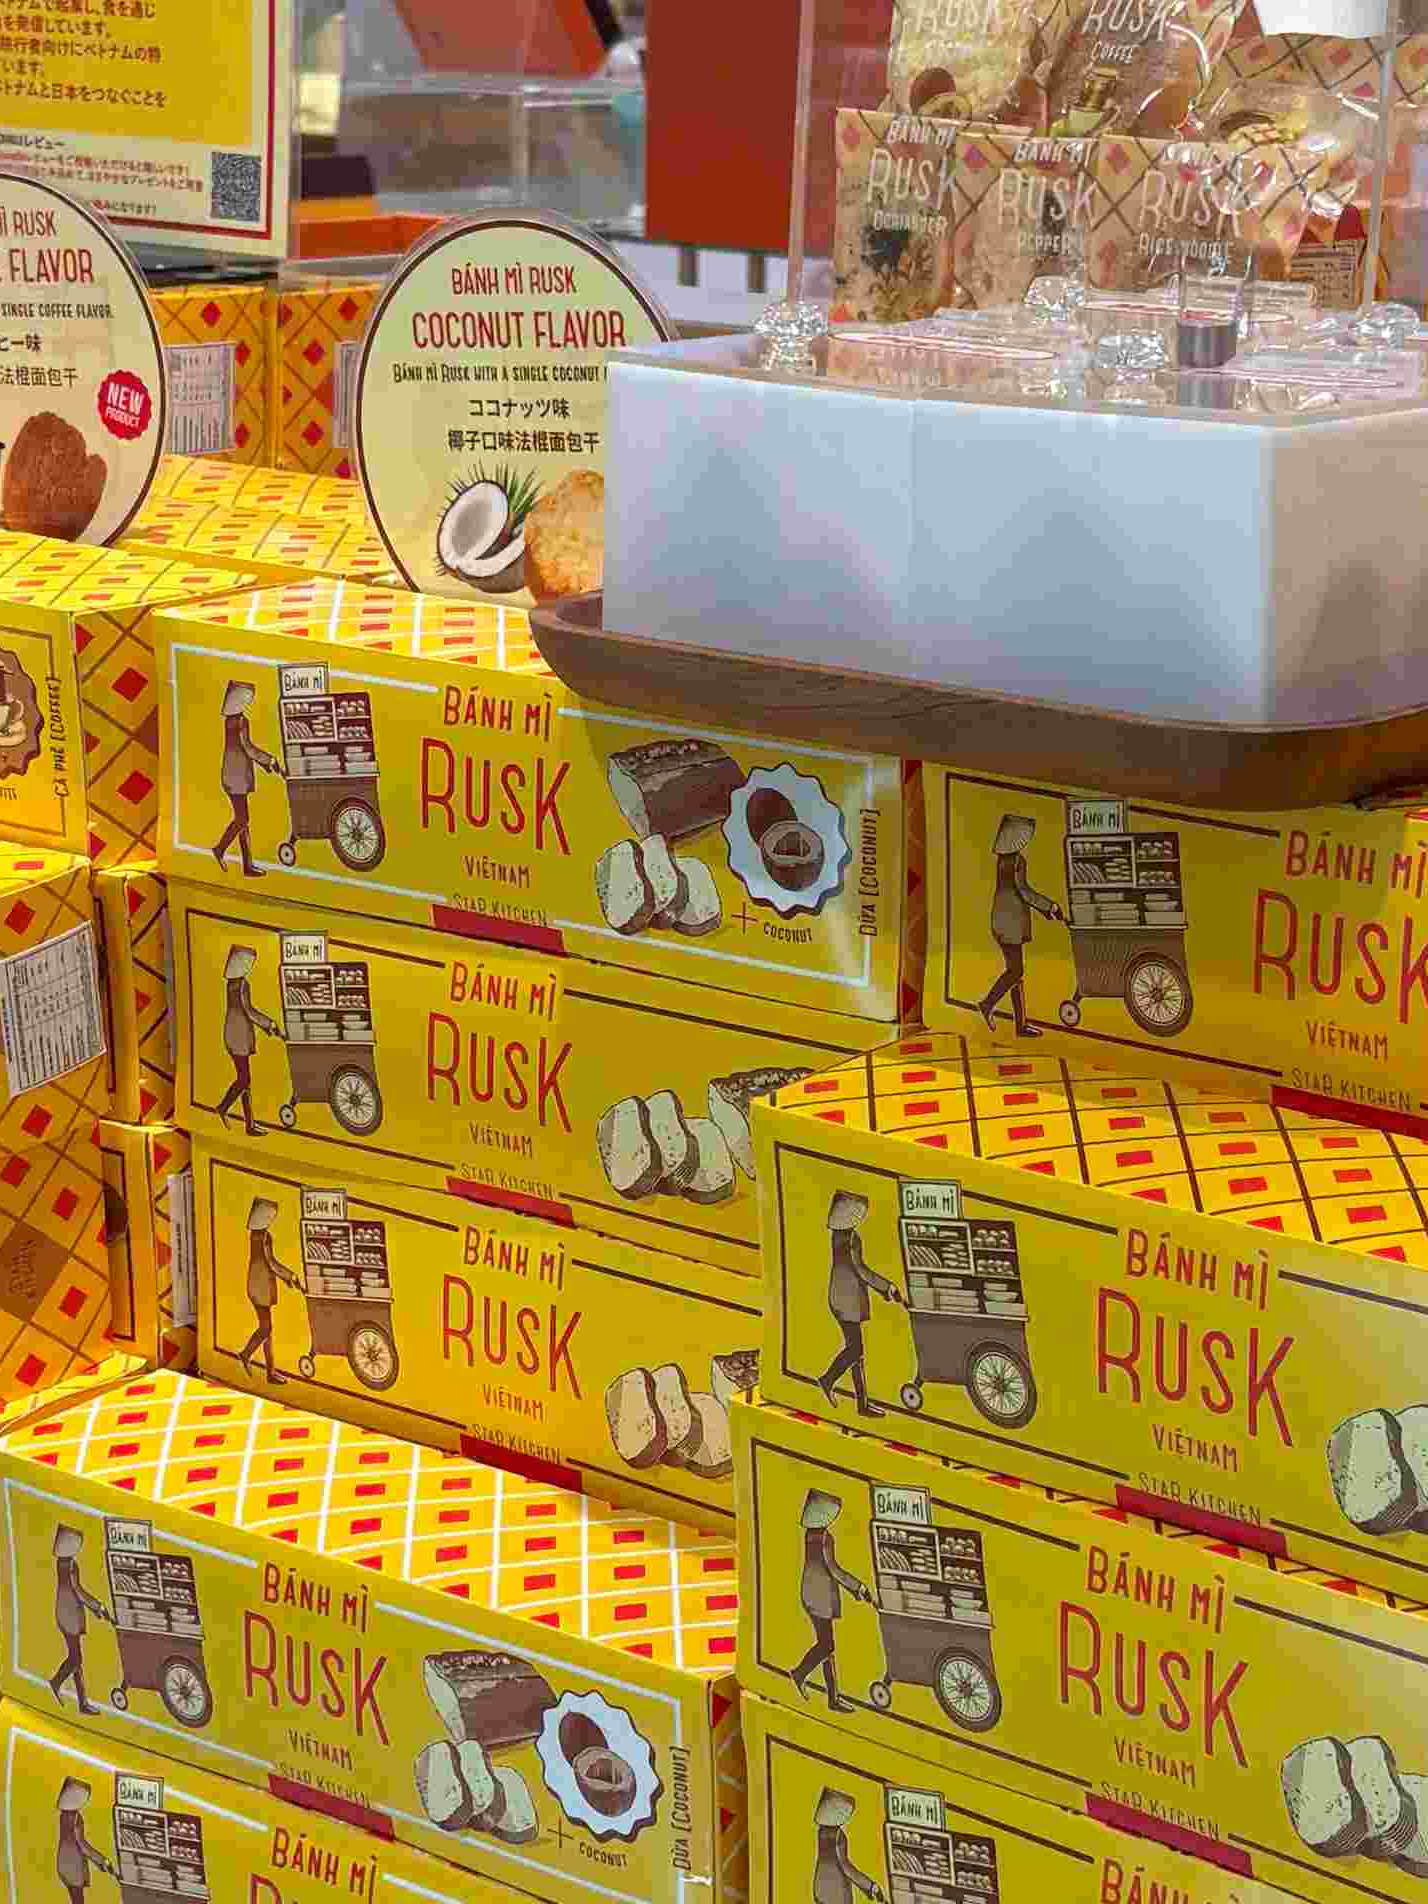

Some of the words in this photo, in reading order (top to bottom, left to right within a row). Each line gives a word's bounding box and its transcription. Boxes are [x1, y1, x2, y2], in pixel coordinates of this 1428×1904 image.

[13, 209, 57, 238] RUSK
[9, 248, 94, 283] FLAVOR
[452, 262, 499, 295] BÁNH
[505, 262, 524, 295] MÌ
[529, 266, 577, 294] RUSK
[1, 302, 34, 318] SINGLE
[37, 302, 74, 319] COFFEE
[413, 311, 524, 349] COCONUT
[533, 310, 626, 349] FLAVOR
[107, 382, 144, 413] NEW
[469, 397, 571, 419] ココナッツ味
[106, 406, 140, 428] PRODUCT
[447, 429, 600, 454] 椰子口味法棍面包干
[444, 685, 513, 732] BÁNH
[524, 691, 553, 742] MÌ
[421, 736, 572, 857] RUSK
[1285, 830, 1376, 884] BÁNH
[1391, 840, 1428, 898] MÌ
[763, 921, 813, 944] COCONUT
